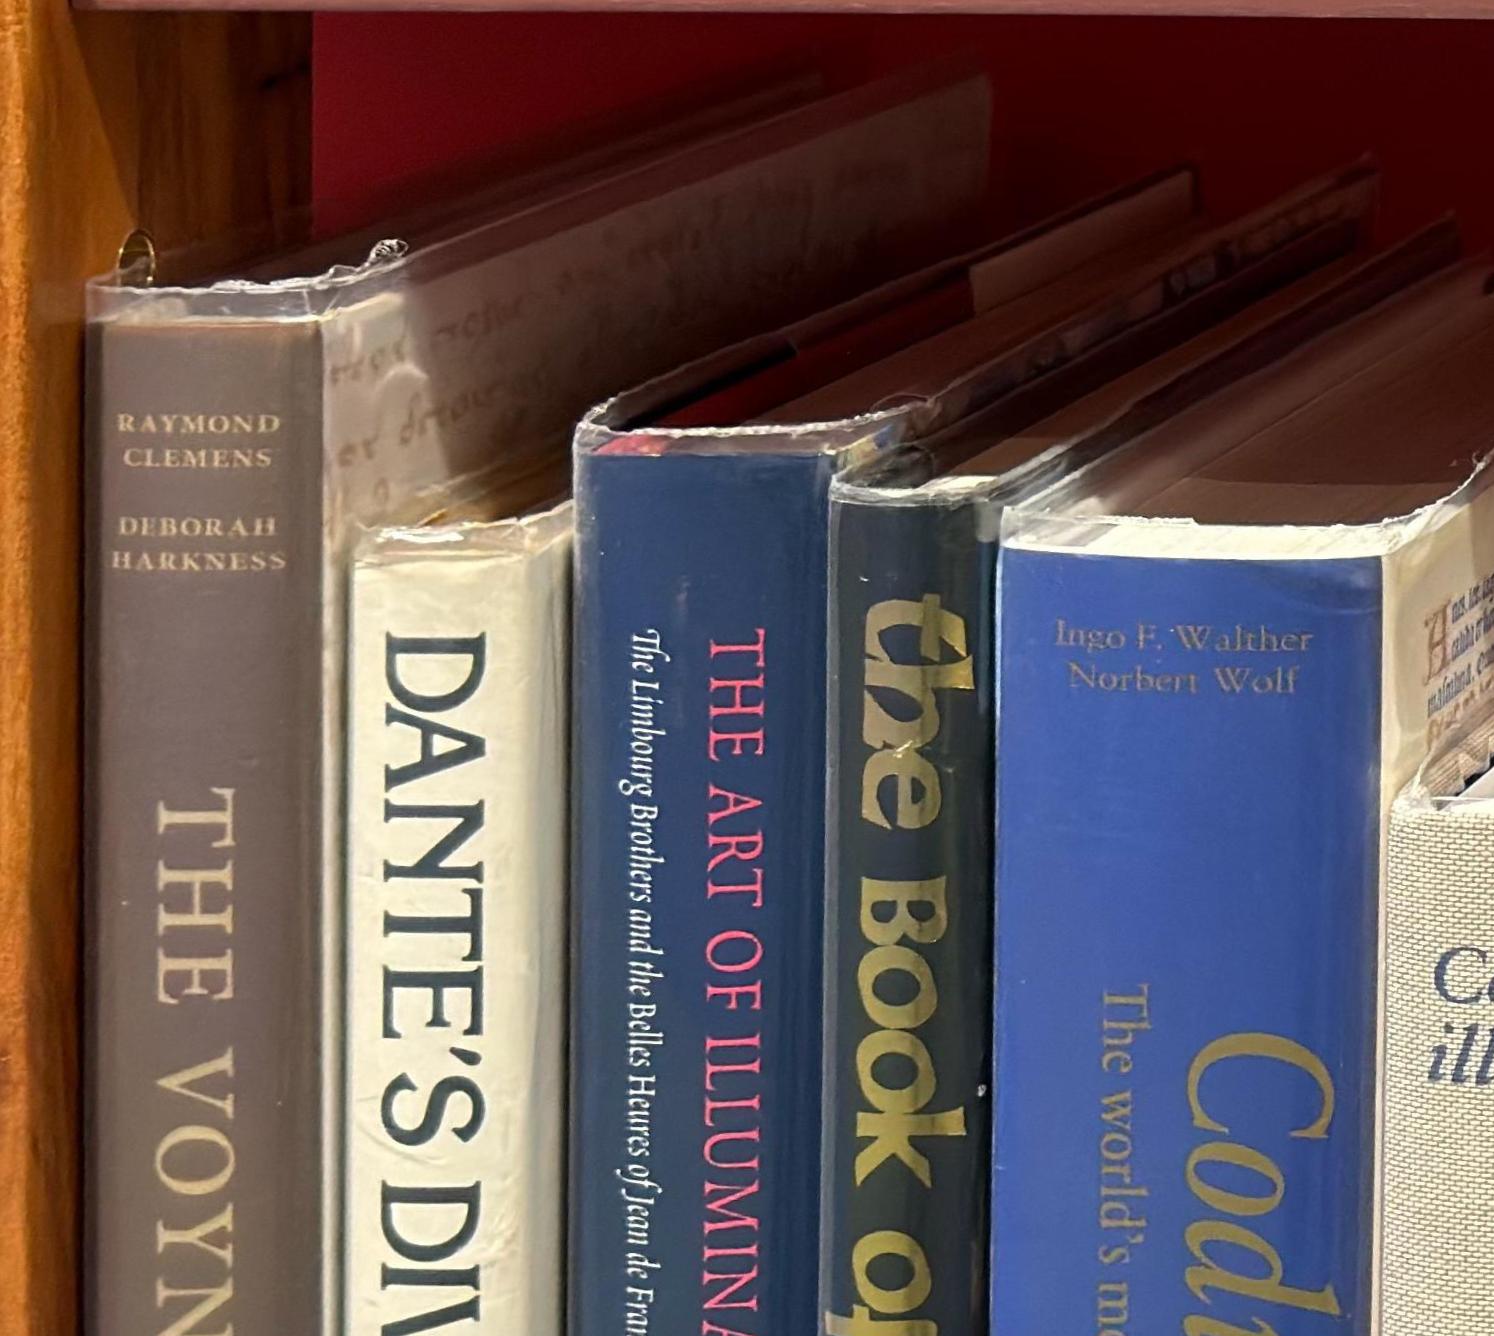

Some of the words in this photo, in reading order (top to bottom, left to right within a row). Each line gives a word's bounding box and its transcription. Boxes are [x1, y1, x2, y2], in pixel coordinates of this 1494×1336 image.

[118, 414, 280, 433] RAYMOND
[123, 449, 271, 468] CLEMENS
[120, 517, 275, 536] DEBORAH
[112, 551, 285, 571] HARKNESS
[631, 629, 670, 673] The
[1054, 618, 1126, 654] Ingo
[1136, 623, 1164, 650] F.
[1175, 624, 1314, 652] Walther
[709, 629, 765, 761] THE
[1068, 661, 1199, 694] Norbert
[1214, 664, 1299, 695] Wolf
[618, 680, 666, 797] Limbourg
[629, 804, 664, 902] Brothers
[707, 785, 762, 907] ART
[158, 787, 235, 1004] THE
[381, 632, 485, 1146] DANTE'S
[629, 909, 664, 955] and
[628, 961, 664, 996] the
[706, 931, 762, 1009] OF
[628, 1003, 663, 1066] Belles
[1100, 982, 1152, 1075] The
[627, 1075, 655, 1156] Heures
[615, 1163, 662, 1194] of
[1099, 1091, 1148, 1264] world's
[621, 1187, 655, 1246] Jean
[626, 1253, 661, 1279] de
